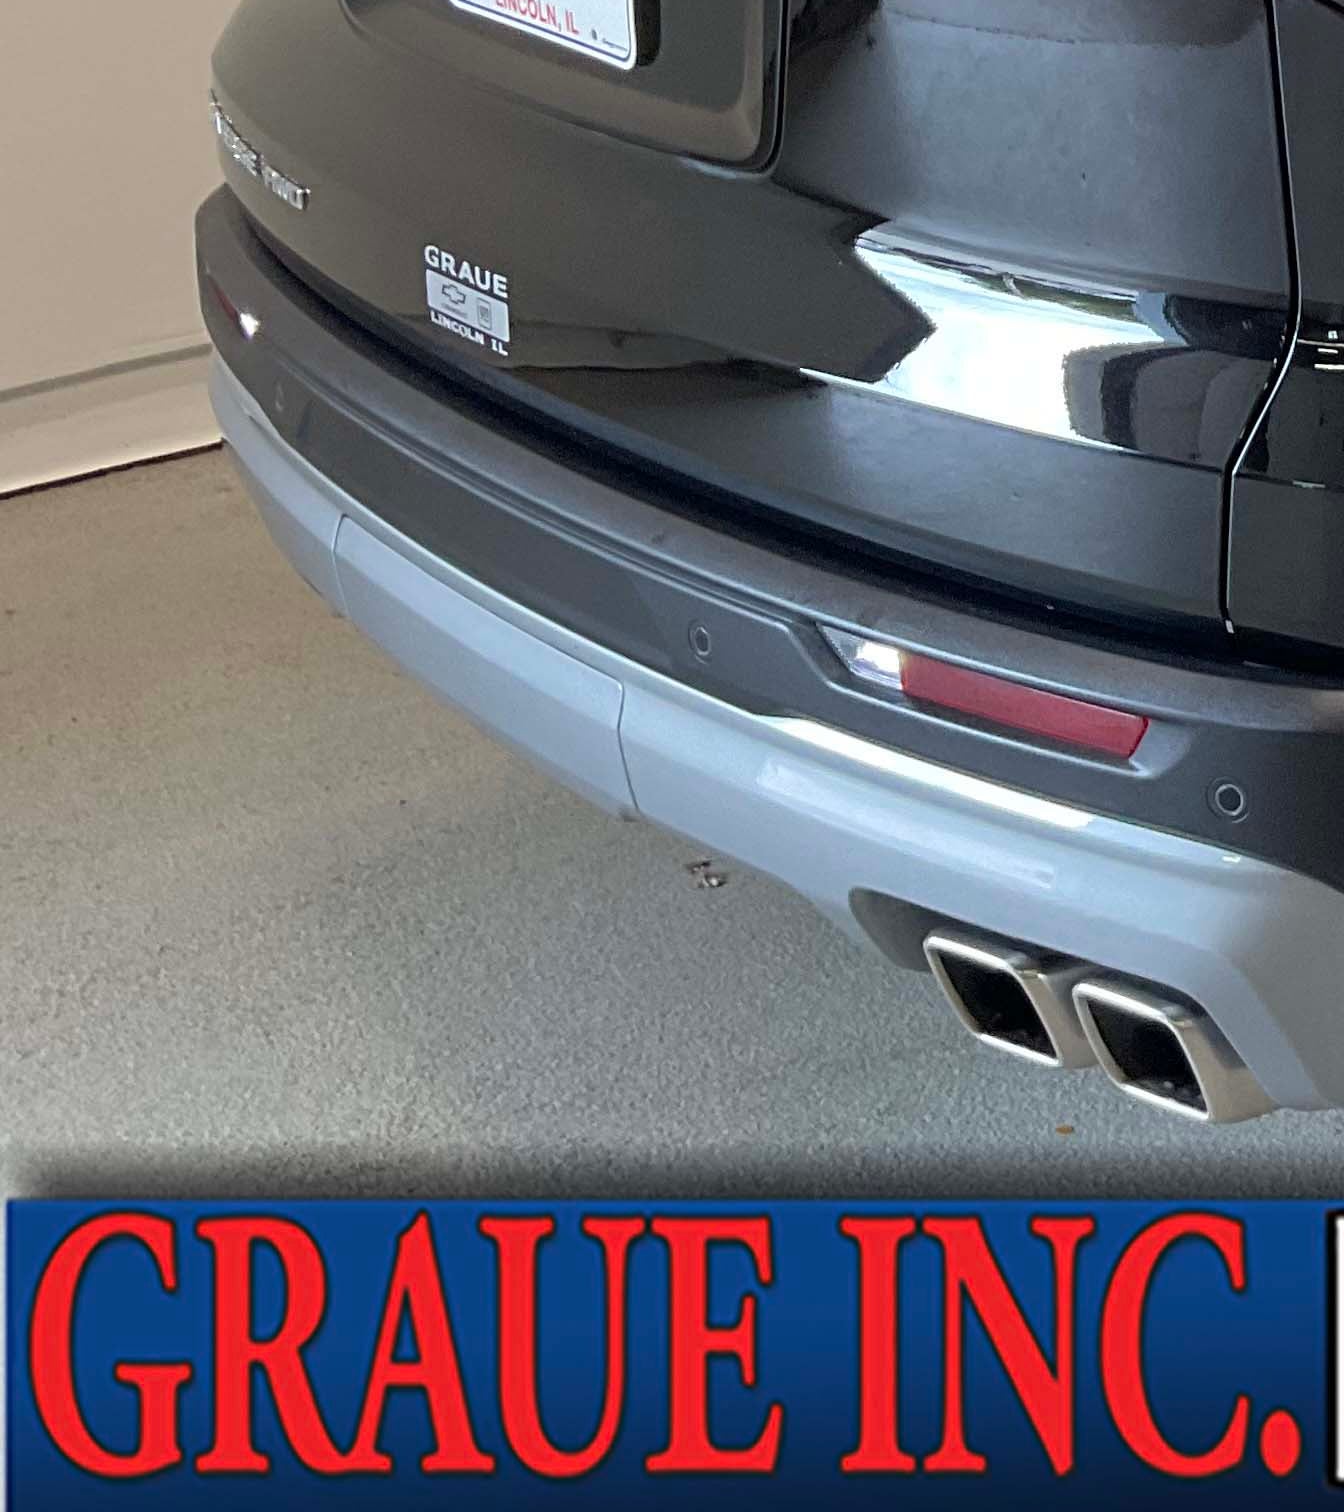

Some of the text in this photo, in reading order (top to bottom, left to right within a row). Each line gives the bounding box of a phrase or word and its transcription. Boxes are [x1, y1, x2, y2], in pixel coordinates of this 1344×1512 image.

[564, 11, 581, 36] IL
[424, 244, 509, 299] GRAUE
[430, 309, 485, 345] LINCOLN
[490, 338, 509, 357] IL
